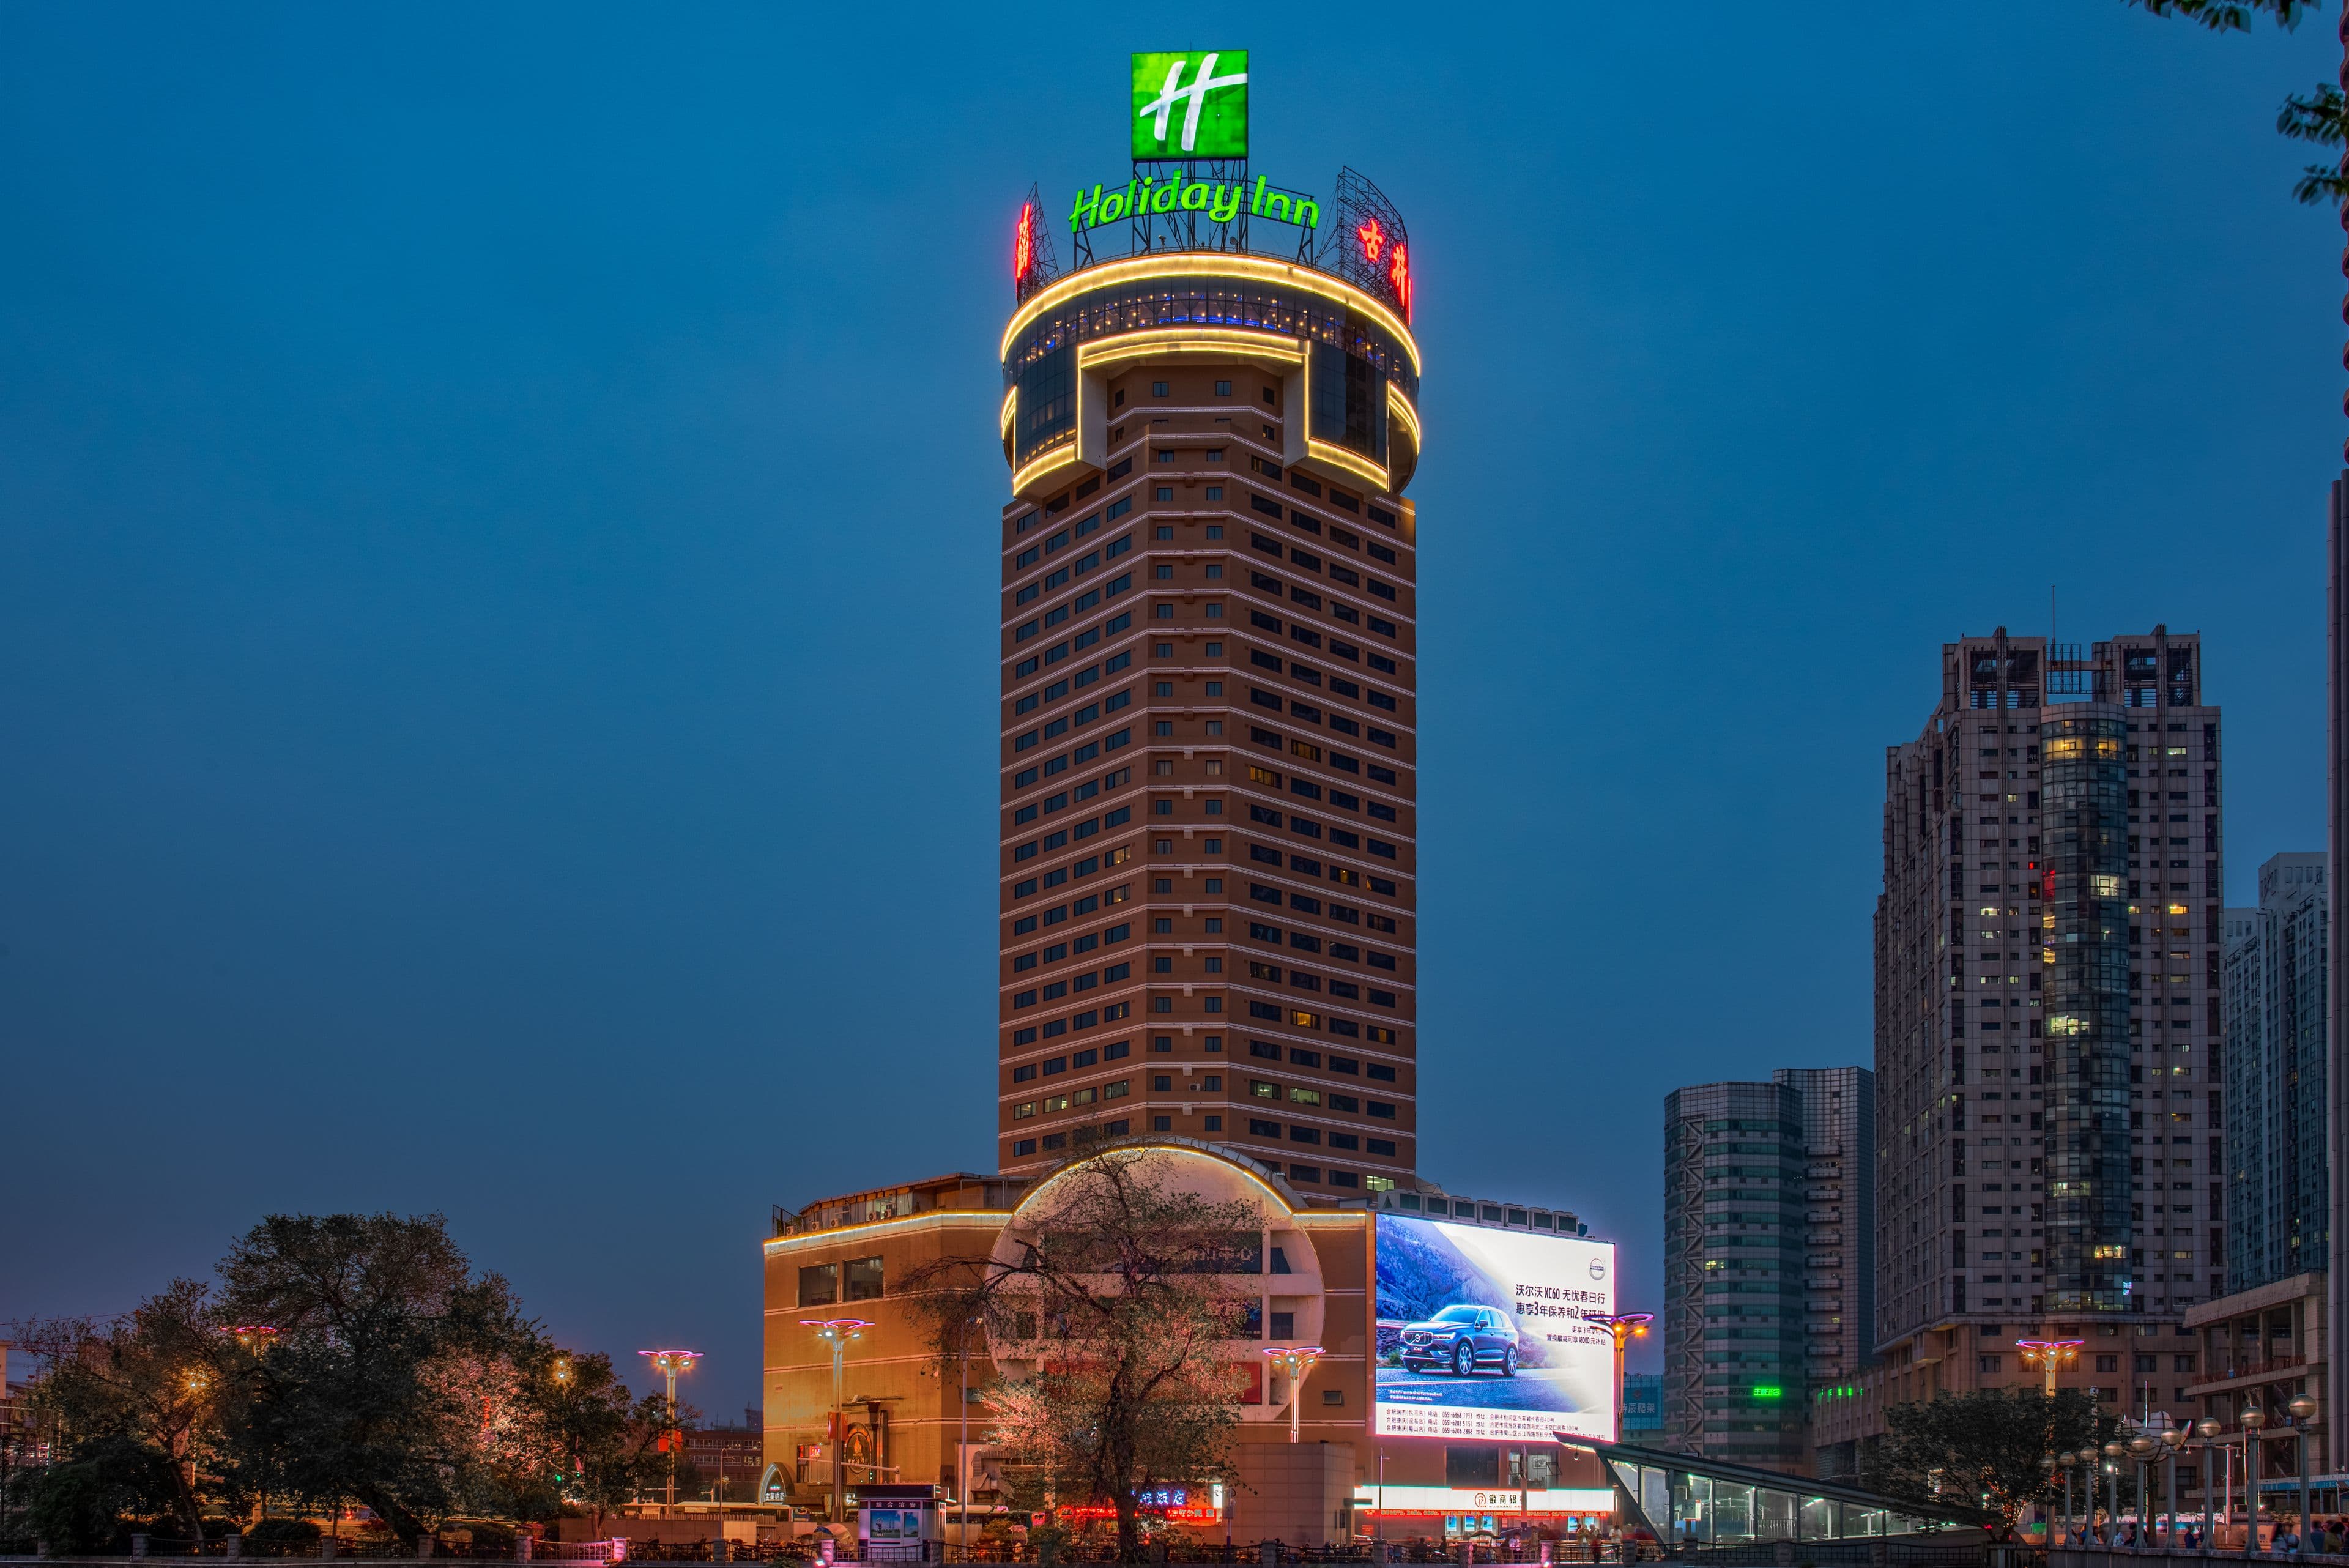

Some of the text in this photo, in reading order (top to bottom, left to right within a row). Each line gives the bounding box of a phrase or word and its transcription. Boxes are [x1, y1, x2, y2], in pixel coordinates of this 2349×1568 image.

[1069, 169, 1319, 233] Holiday Inn
[1516, 1284, 1606, 1304] 沃尔沃 XC60 无忧春日行
[1489, 1494, 1522, 1504] 徽商银
